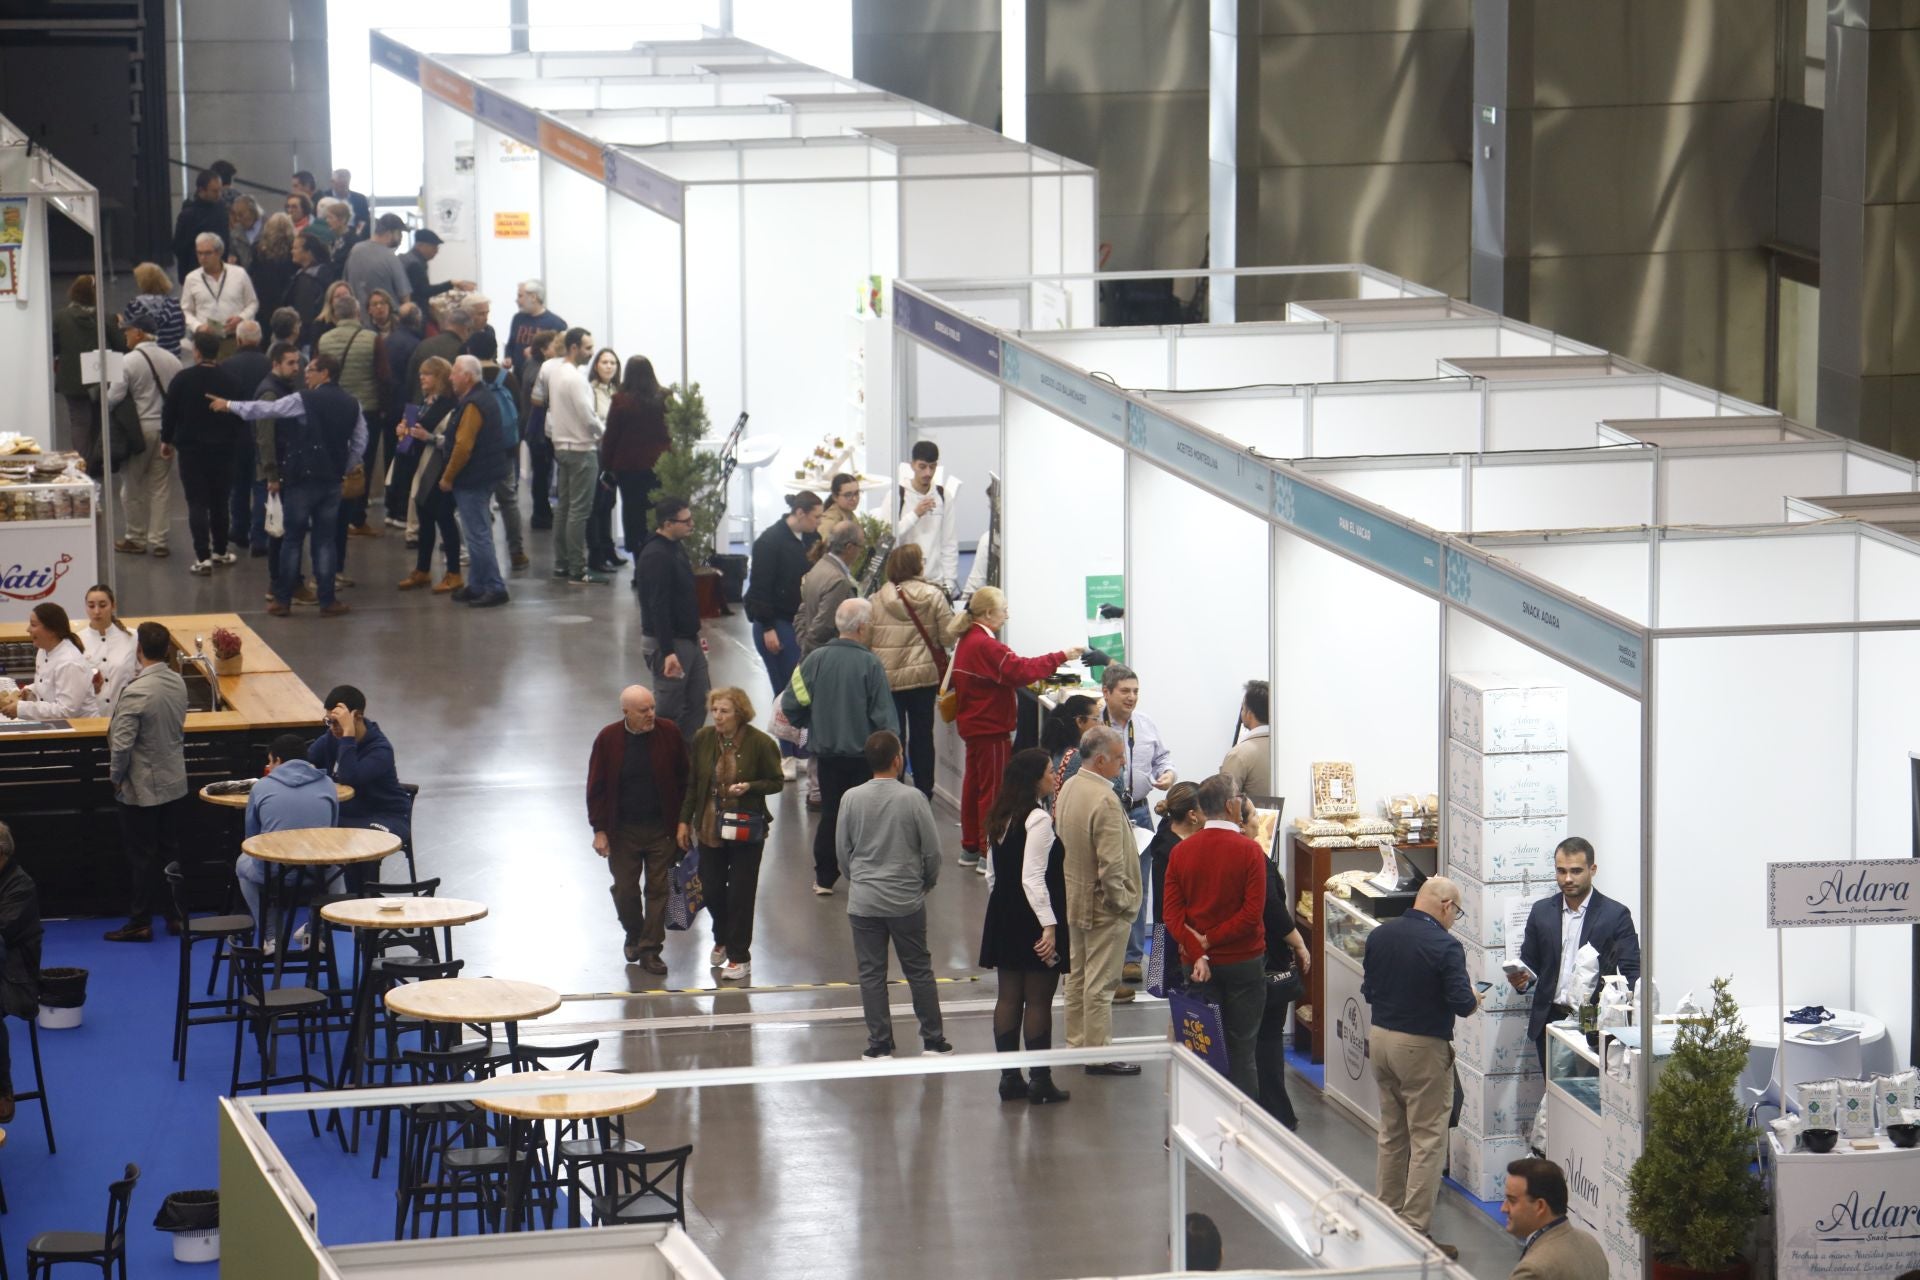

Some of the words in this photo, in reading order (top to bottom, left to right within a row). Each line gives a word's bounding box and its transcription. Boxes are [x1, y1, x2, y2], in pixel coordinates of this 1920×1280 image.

[1339, 516, 1349, 531] PAN
[1349, 521, 1356, 534] EL
[1522, 601, 1541, 618] SNACK
[1540, 610, 1560, 629] ADARA
[1806, 869, 1910, 906] Adara
[1848, 906, 1869, 914] Snack
[1565, 1147, 1599, 1209] Adara
[1866, 1232, 1889, 1242] Snack
